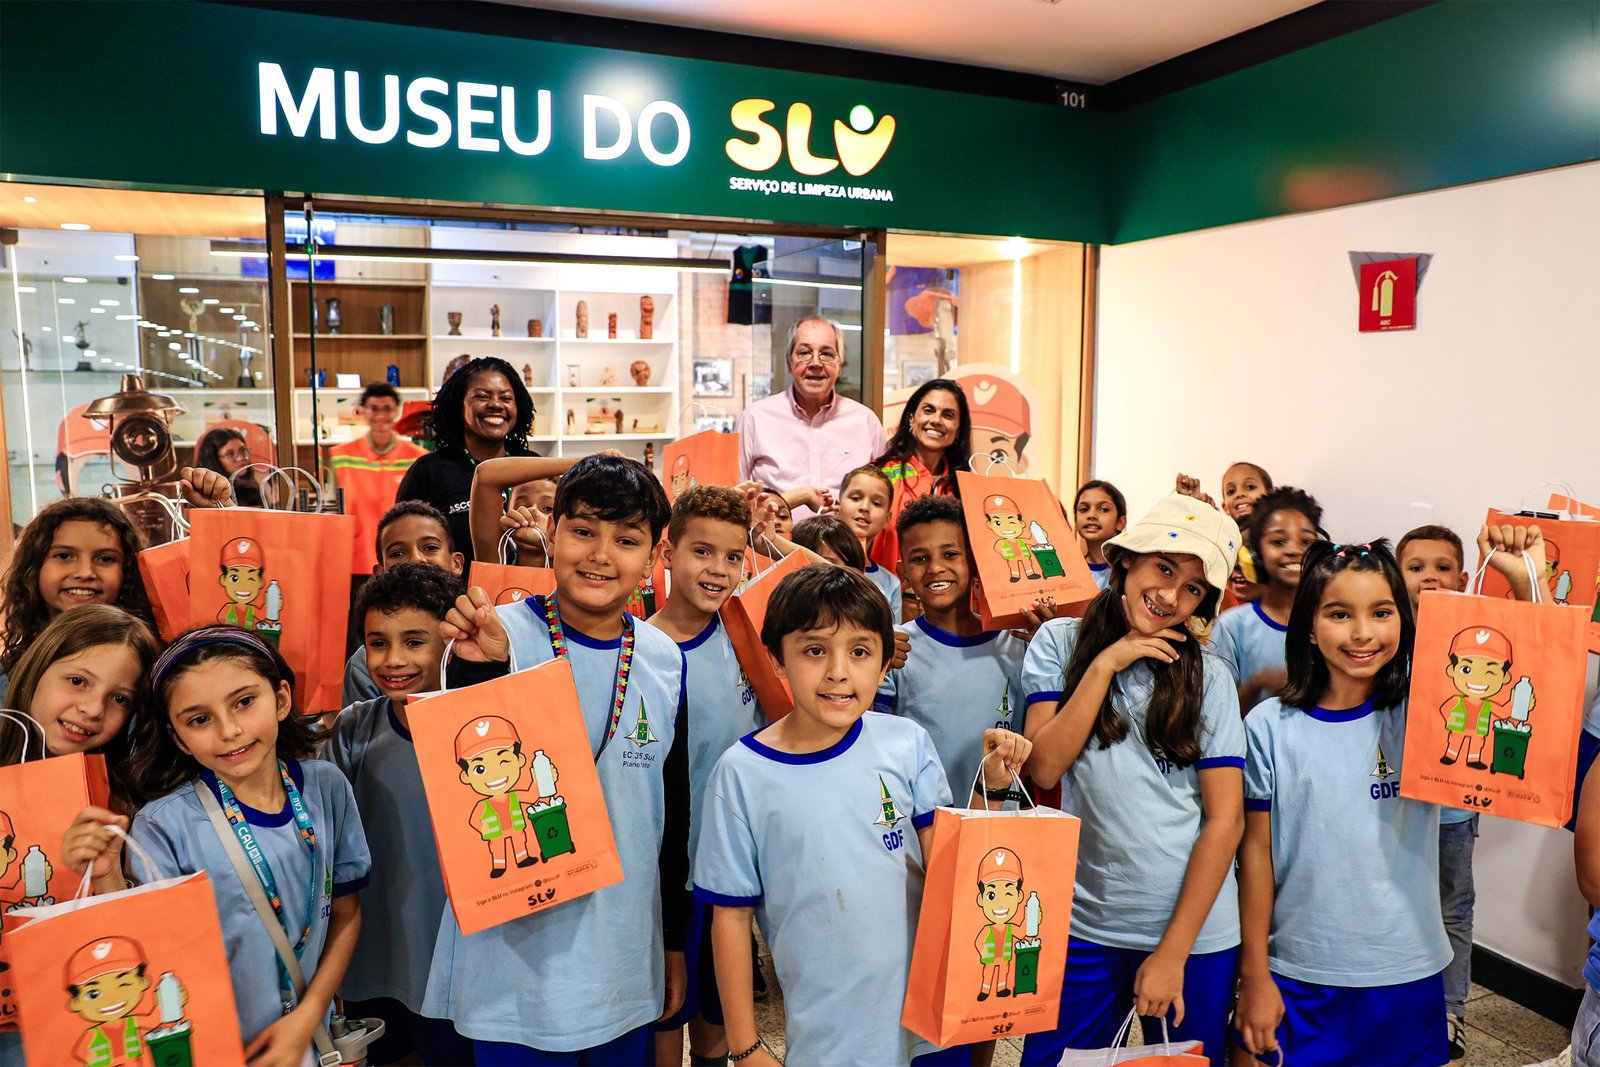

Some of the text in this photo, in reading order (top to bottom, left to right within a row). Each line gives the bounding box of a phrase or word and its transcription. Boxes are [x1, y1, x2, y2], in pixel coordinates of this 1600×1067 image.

[1061, 91, 1086, 108] 101
[258, 61, 896, 177] MUSEU DO SLU
[729, 176, 894, 202] SERVIÇO DE LIMPEZA URBANA
[622, 750, 656, 762] EC 35 Sul
[1155, 758, 1174, 775] DF
[1370, 780, 1401, 800] GDF
[238, 826, 256, 851] CAU
[882, 828, 904, 852] GDF
